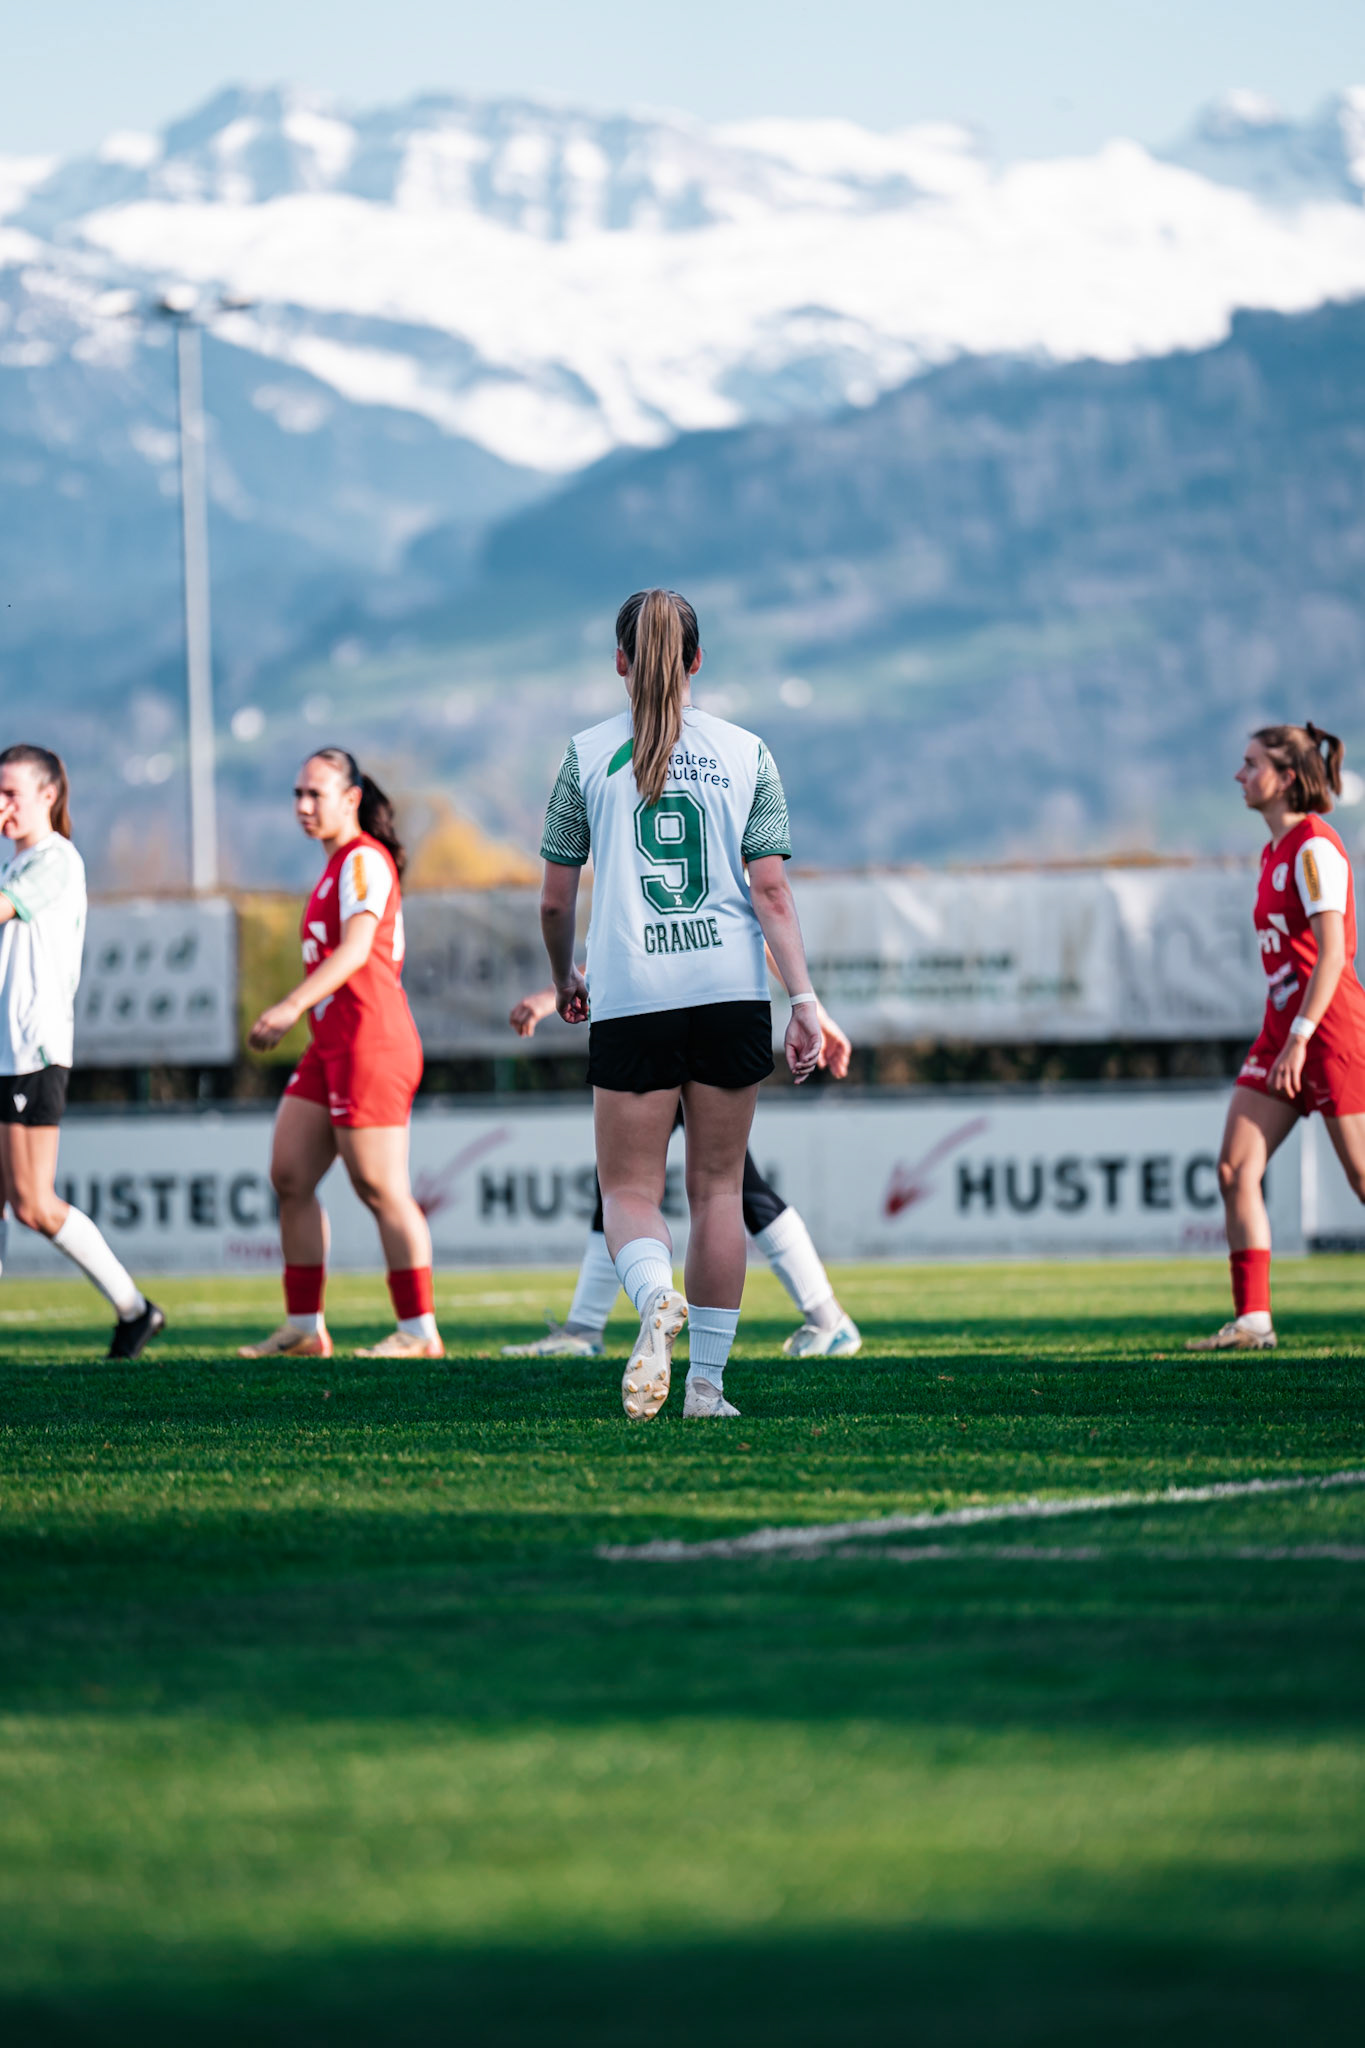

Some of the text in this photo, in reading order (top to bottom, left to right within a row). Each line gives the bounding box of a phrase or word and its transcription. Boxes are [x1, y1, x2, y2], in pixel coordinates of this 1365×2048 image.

[633, 789, 710, 915] 9
[643, 916, 724, 956] GRANDE
[62, 1174, 281, 1230] USTEC
[956, 1153, 1270, 1213] HUSTEC
